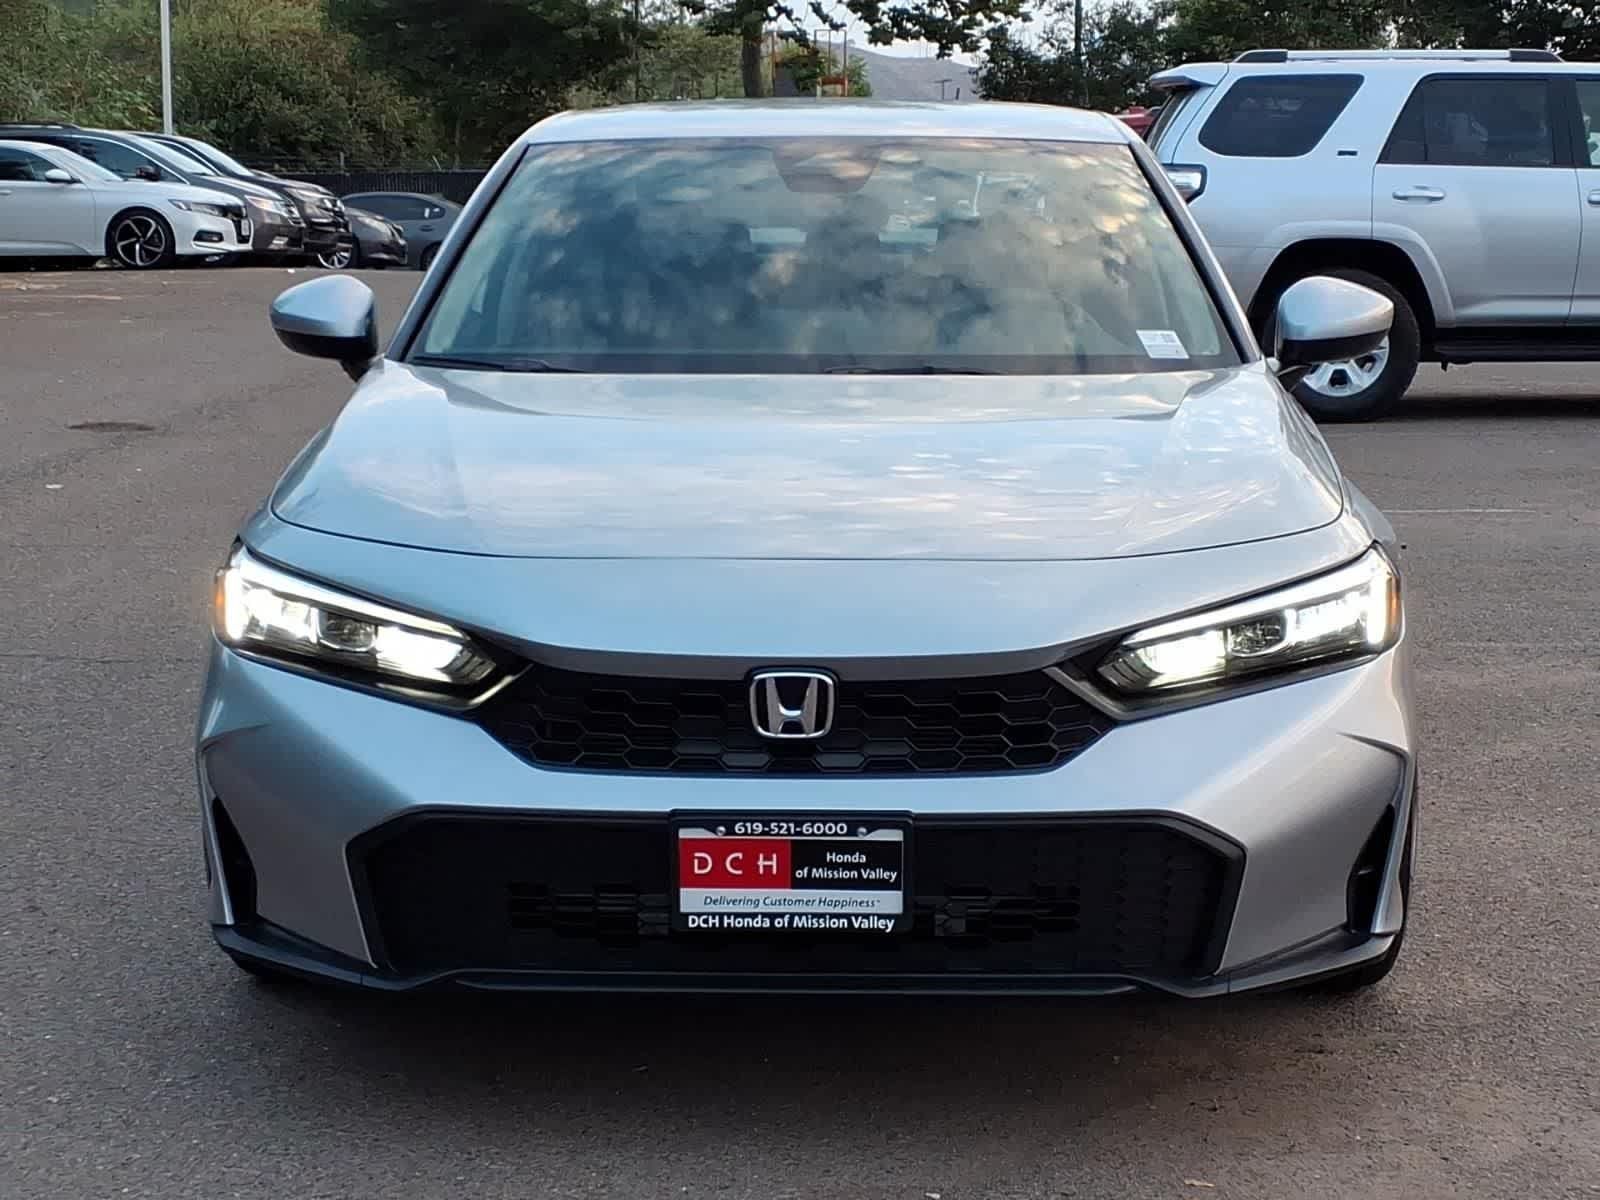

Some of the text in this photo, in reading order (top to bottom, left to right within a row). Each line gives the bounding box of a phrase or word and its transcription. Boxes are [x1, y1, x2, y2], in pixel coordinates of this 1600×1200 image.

[734, 822, 848, 834] 619-521-6000
[826, 852, 866, 863] Honda
[795, 867, 897, 882] of Mission Valley
[703, 895, 760, 909] Delivering
[763, 896, 816, 908] Customer
[688, 915, 895, 933] DCH Honda of Mission Valley
